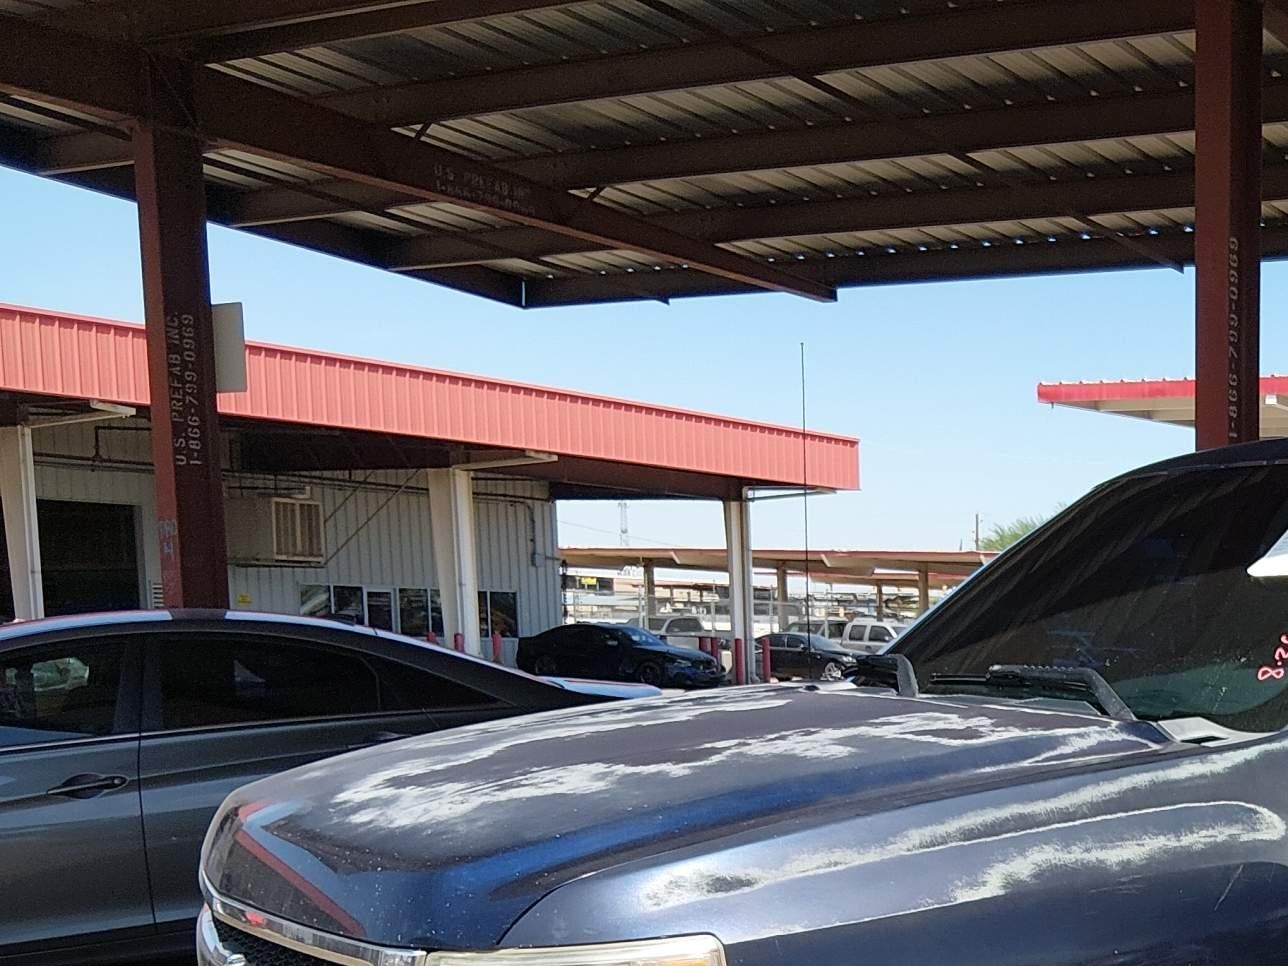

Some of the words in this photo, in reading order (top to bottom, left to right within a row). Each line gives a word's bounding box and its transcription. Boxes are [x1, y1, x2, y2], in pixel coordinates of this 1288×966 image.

[166, 311, 181, 345] INC.
[1228, 237, 1239, 439] 1-866-799-0969
[168, 353, 185, 423] PREFAB
[181, 313, 203, 466] 1-866-799-0969
[174, 432, 188, 466] U.S.
